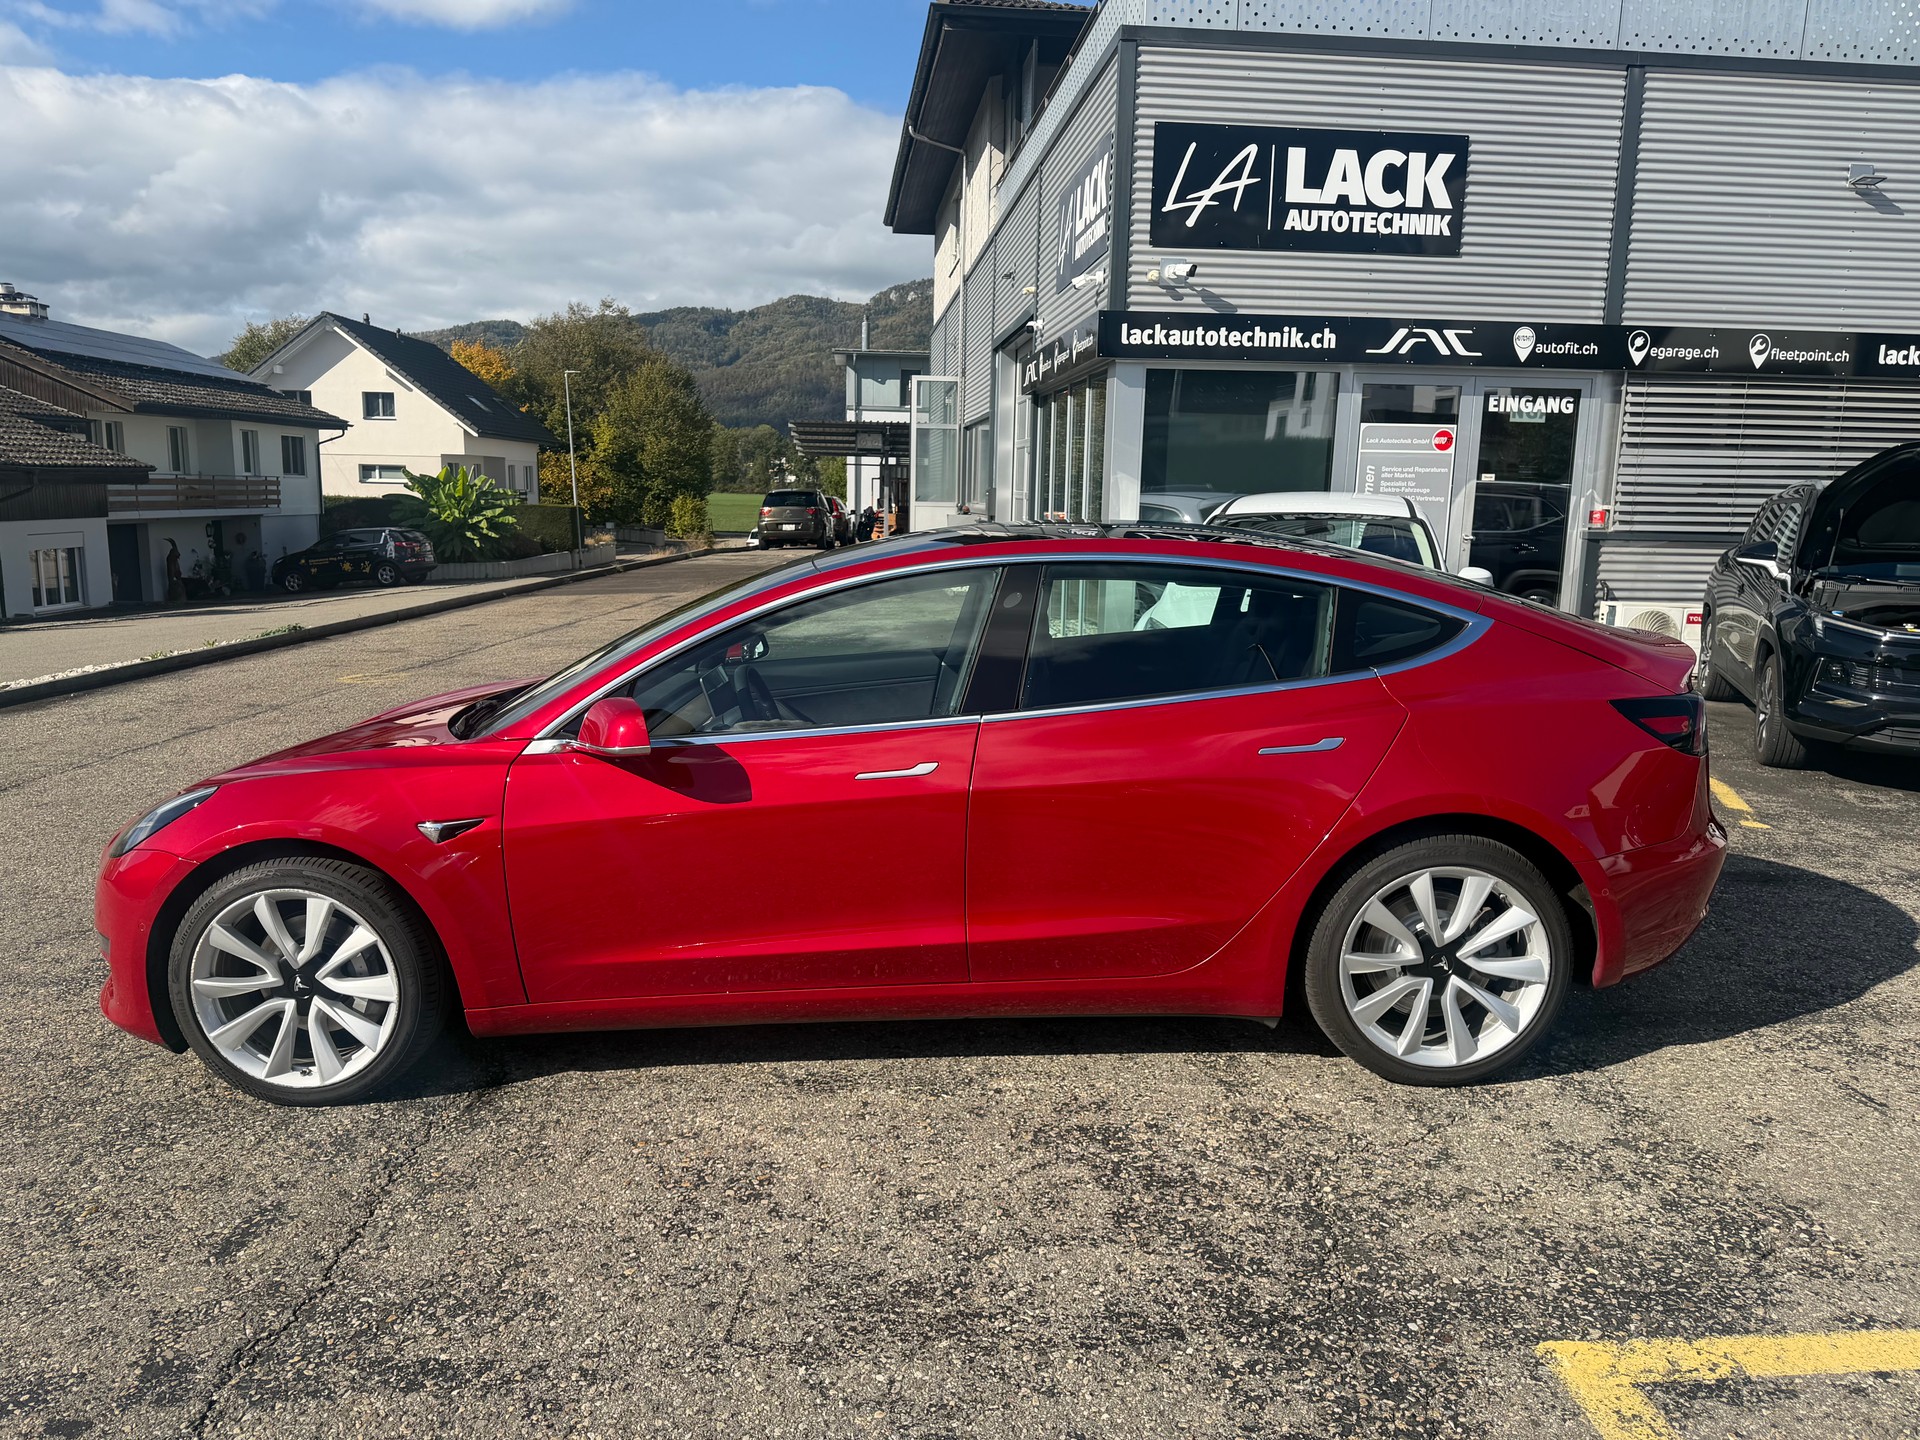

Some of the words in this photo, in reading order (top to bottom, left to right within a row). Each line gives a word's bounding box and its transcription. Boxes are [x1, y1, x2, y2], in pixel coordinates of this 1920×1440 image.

[1285, 146, 1456, 210] LACK
[1075, 152, 1109, 237] LACK
[1284, 208, 1452, 236] AUTOTECHNIK
[1121, 323, 1336, 349] lackautotechnik.ch
[1535, 341, 1599, 355] autofit.ch
[1650, 346, 1719, 360] egarage.ch
[1770, 347, 1850, 363] fleetpoint.ch
[1488, 395, 1575, 414] EINGANG
[1414, 466, 1449, 474] Reparaturen
[1380, 480, 1407, 488] Spezialist
[178, 896, 217, 947] UltraContact
